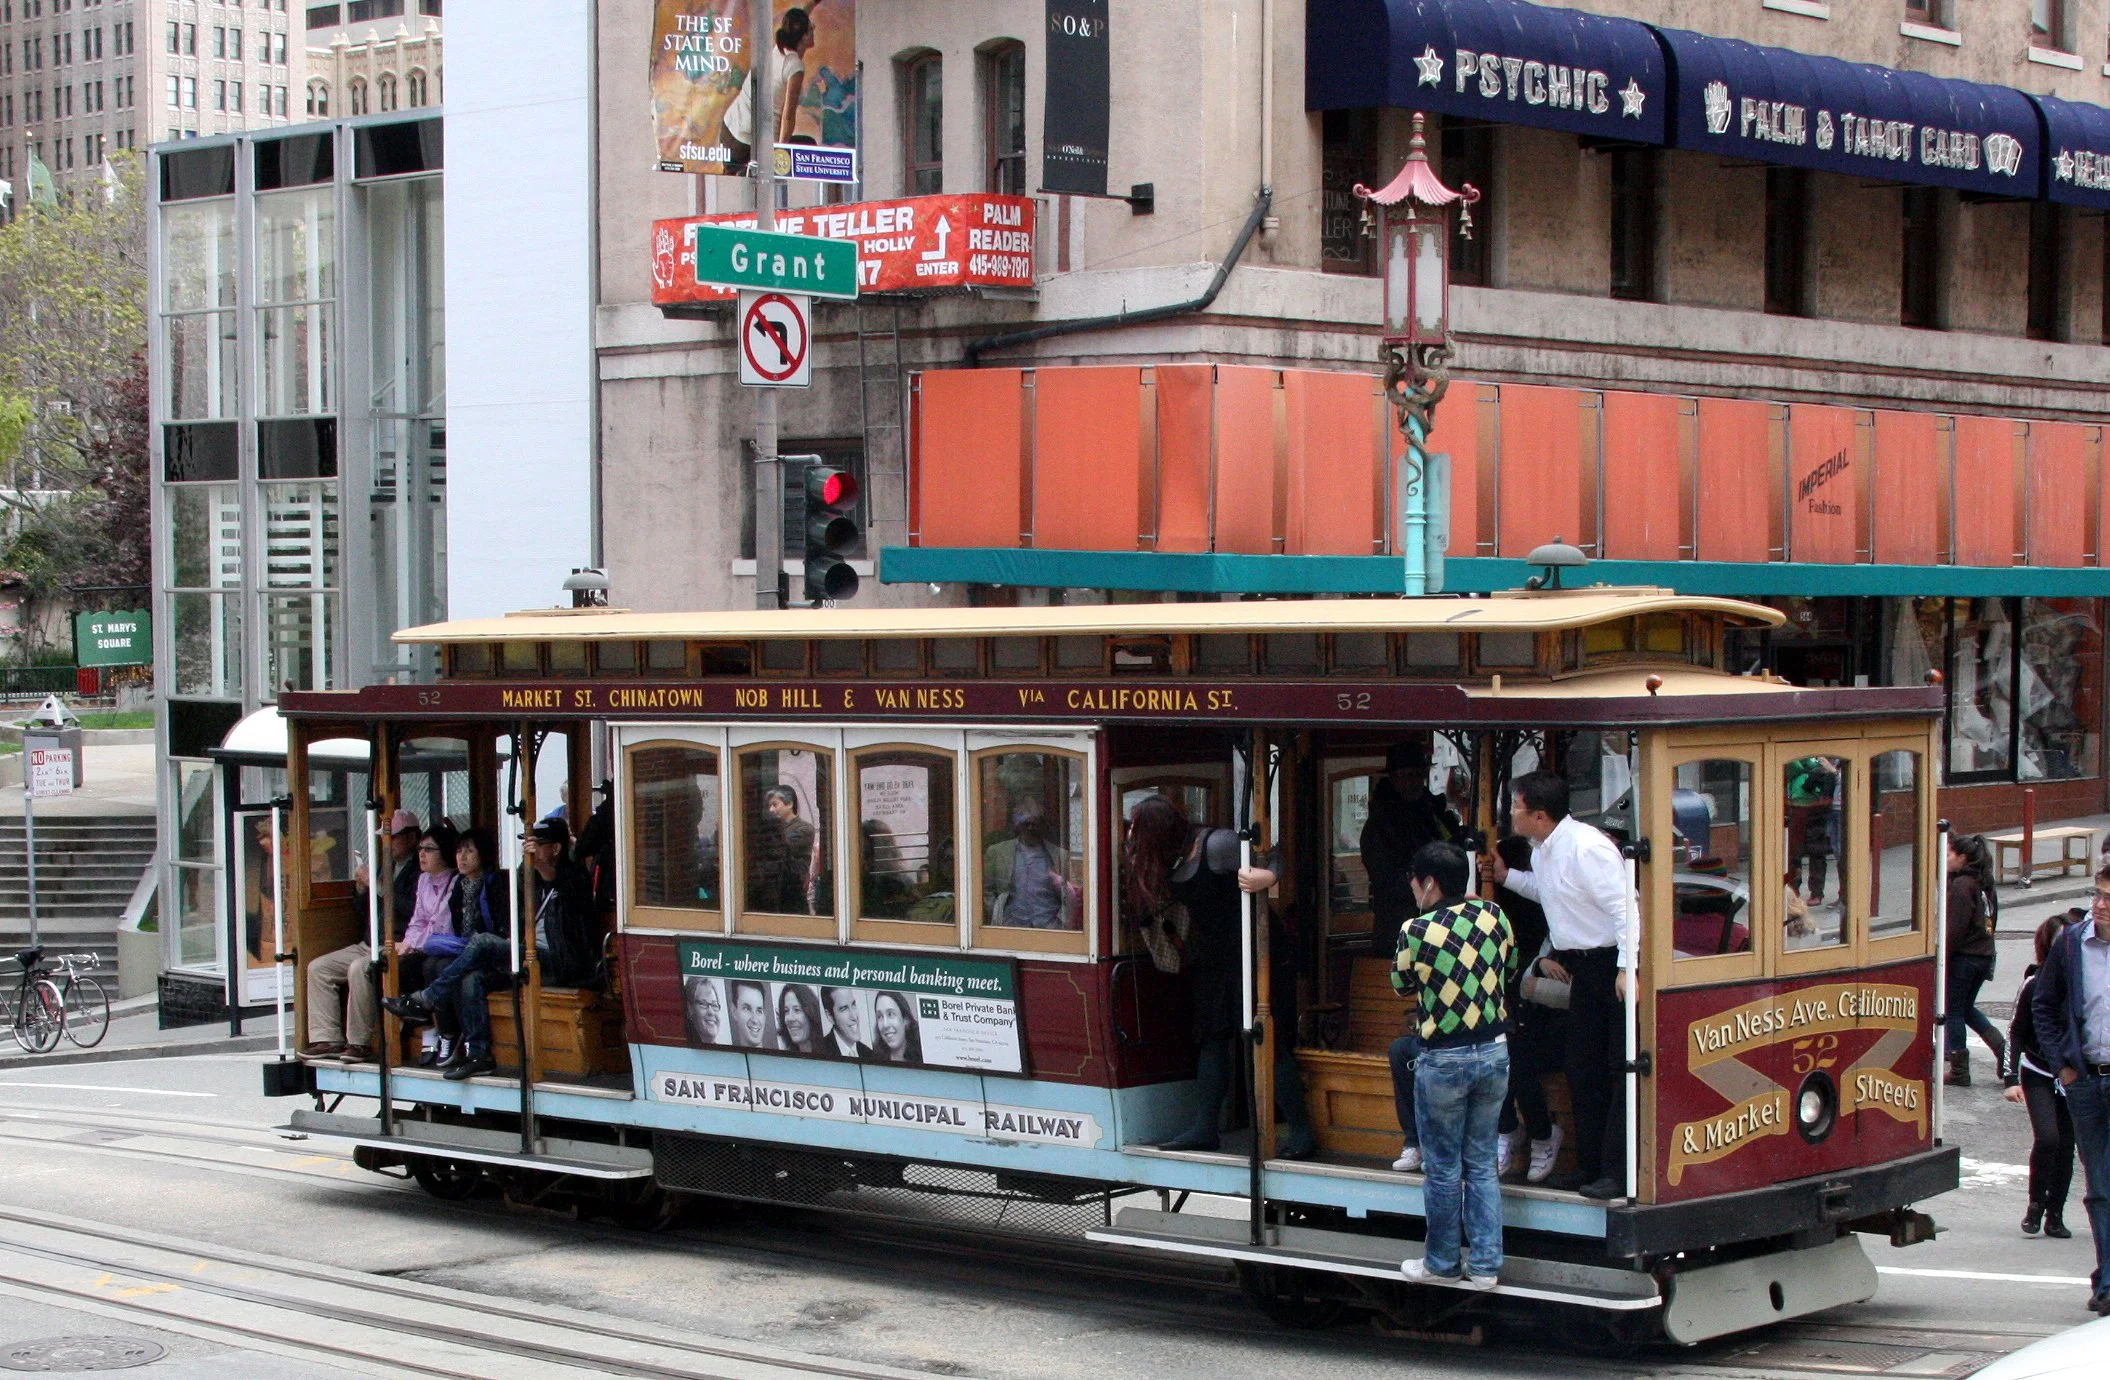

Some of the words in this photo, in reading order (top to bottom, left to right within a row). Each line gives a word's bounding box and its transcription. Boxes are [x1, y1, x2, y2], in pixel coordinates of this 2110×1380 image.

[675, 15, 709, 33] THE
[714, 17, 733, 34] SF
[664, 34, 714, 51] STATE
[719, 37, 742, 54] OF
[675, 54, 732, 72] MIND.
[1455, 49, 1610, 114] PSYCHIC
[1741, 97, 1807, 146] PALM
[1815, 110, 1835, 150] &
[1841, 112, 1914, 162] TAROT
[1920, 126, 1980, 171] CARD
[680, 141, 731, 162] sfsu.edu
[795, 153, 810, 163] SAN
[811, 154, 851, 166] FRANCISCO
[795, 164, 813, 174] STATE
[814, 166, 850, 176] UNIVERSITY
[812, 206, 914, 238] TELLER
[983, 202, 1021, 226] PALM
[863, 236, 916, 254] HOLLY
[969, 229, 1030, 253] READER
[731, 243, 825, 280] Grant
[915, 261, 959, 276] ENTER
[968, 253, 1029, 279] 415-989-7917
[1798, 448, 1850, 503] IMPERIAL
[1808, 498, 1842, 516] Fashion
[107, 622, 137, 633] MARY'S
[97, 638, 132, 649] SQUARE
[418, 690, 442, 705] 52
[502, 690, 563, 708] MARKET
[574, 690, 596, 708] ST.
[609, 689, 704, 708] CHINATOWN
[735, 688, 769, 707] NOB
[782, 688, 822, 708] HILL
[875, 689, 910, 709] VAN
[917, 689, 965, 708] NESS
[1019, 689, 1045, 708] VIA
[1067, 689, 1198, 710] CALIFORNIA
[1207, 690, 1239, 710] ST.
[1336, 692, 1371, 710] 52
[32, 751, 44, 764] NO
[45, 753, 71, 763] PARKING
[691, 951, 723, 970] Borel
[733, 954, 770, 973] where
[773, 956, 821, 977] business
[824, 961, 850, 979] and
[851, 965, 906, 985] personal
[909, 966, 964, 994] banking
[967, 977, 1002, 992] meet.
[942, 1000, 964, 1011] Borel
[965, 1002, 994, 1014] Private
[943, 1012, 949, 1021] &
[951, 1012, 972, 1023] Trust
[973, 1014, 1014, 1029] Company
[1694, 1024, 1733, 1055] Van
[1735, 1008, 1785, 1041] Ness
[1838, 988, 1916, 1019] California
[1793, 1035, 1839, 1074] 52
[1855, 1074, 1918, 1110] Streets
[664, 1078, 707, 1100] SAN
[714, 1083, 835, 1113] FRANCISCO
[849, 1097, 966, 1127] MUNICIPAL
[979, 1109, 1083, 1139] RAILWAY
[1682, 1125, 1700, 1154] &
[1705, 1097, 1781, 1151] Market
